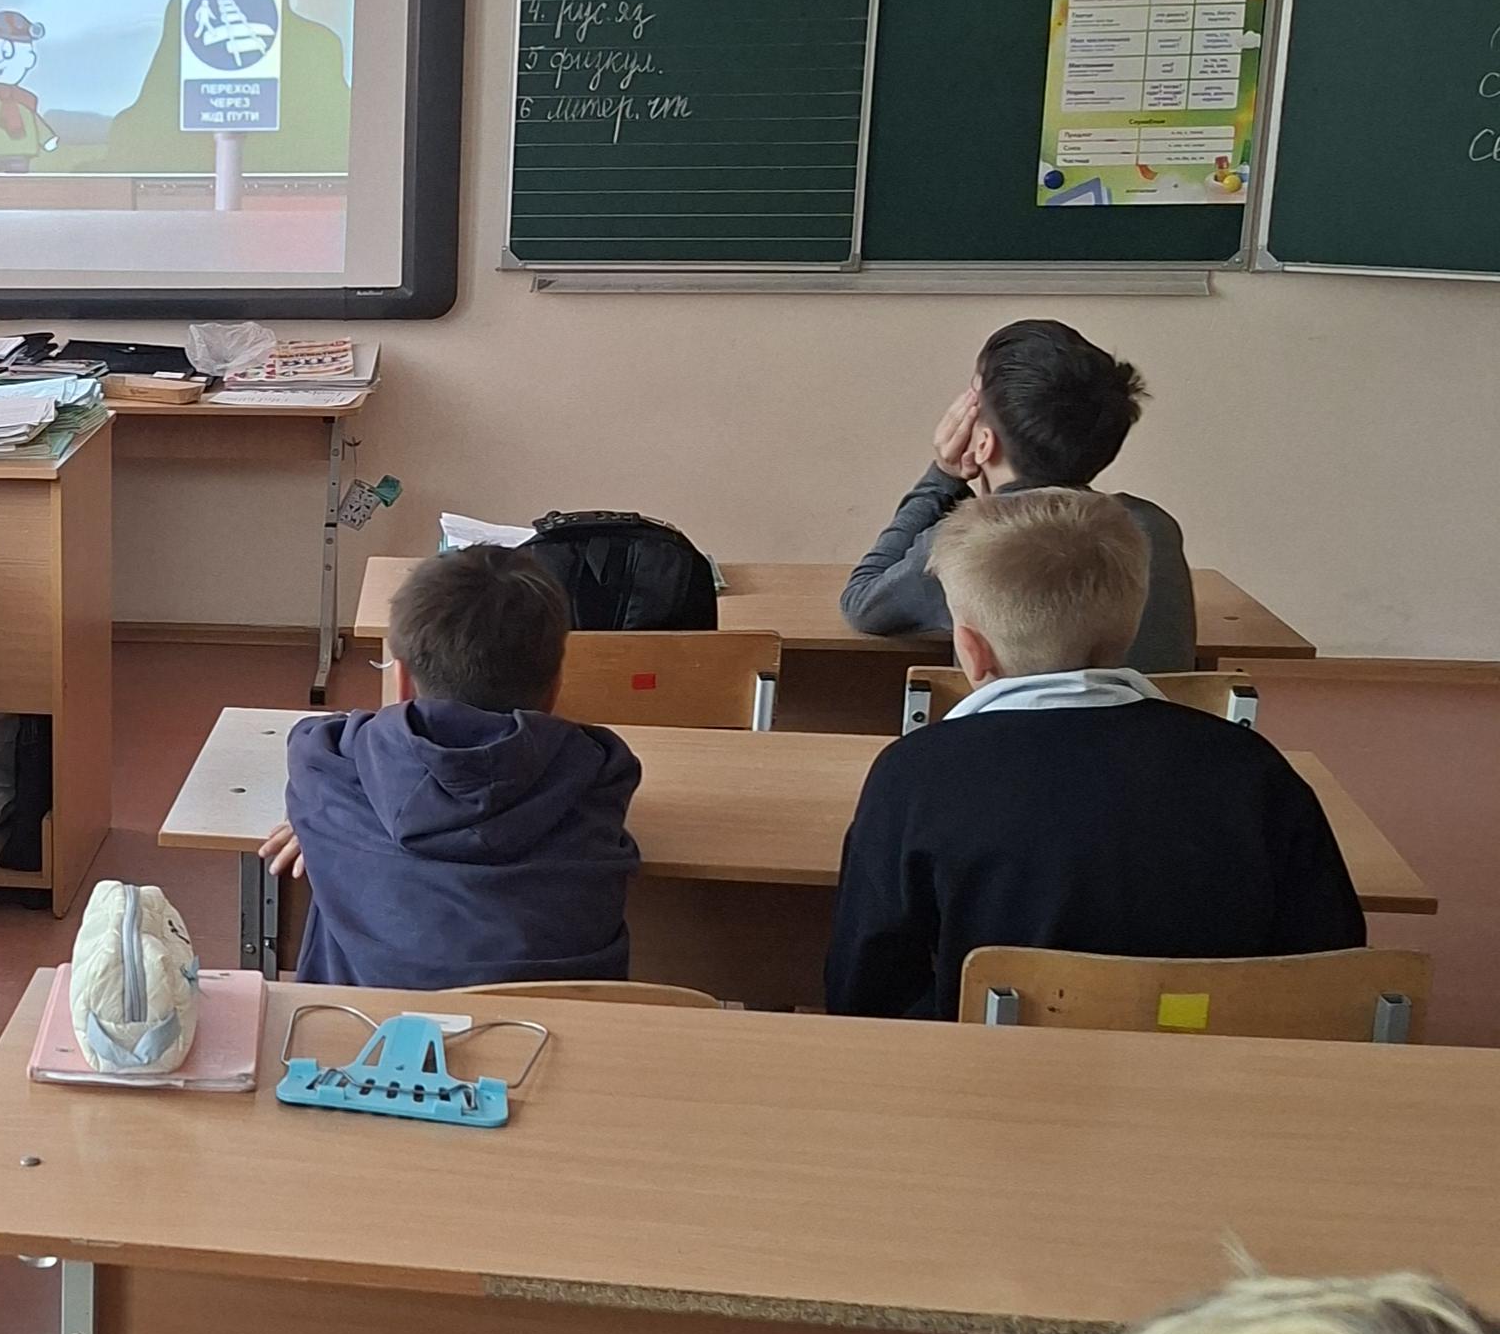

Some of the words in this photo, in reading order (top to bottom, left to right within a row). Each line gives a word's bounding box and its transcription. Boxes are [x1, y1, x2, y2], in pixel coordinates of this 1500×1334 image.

[525, 46, 545, 70] 5
[201, 83, 261, 95] ПЕРЕХОД
[210, 97, 250, 108] ЧЕРЕЗ
[520, 97, 534, 118] 6
[227, 111, 260, 122] ПУТИ
